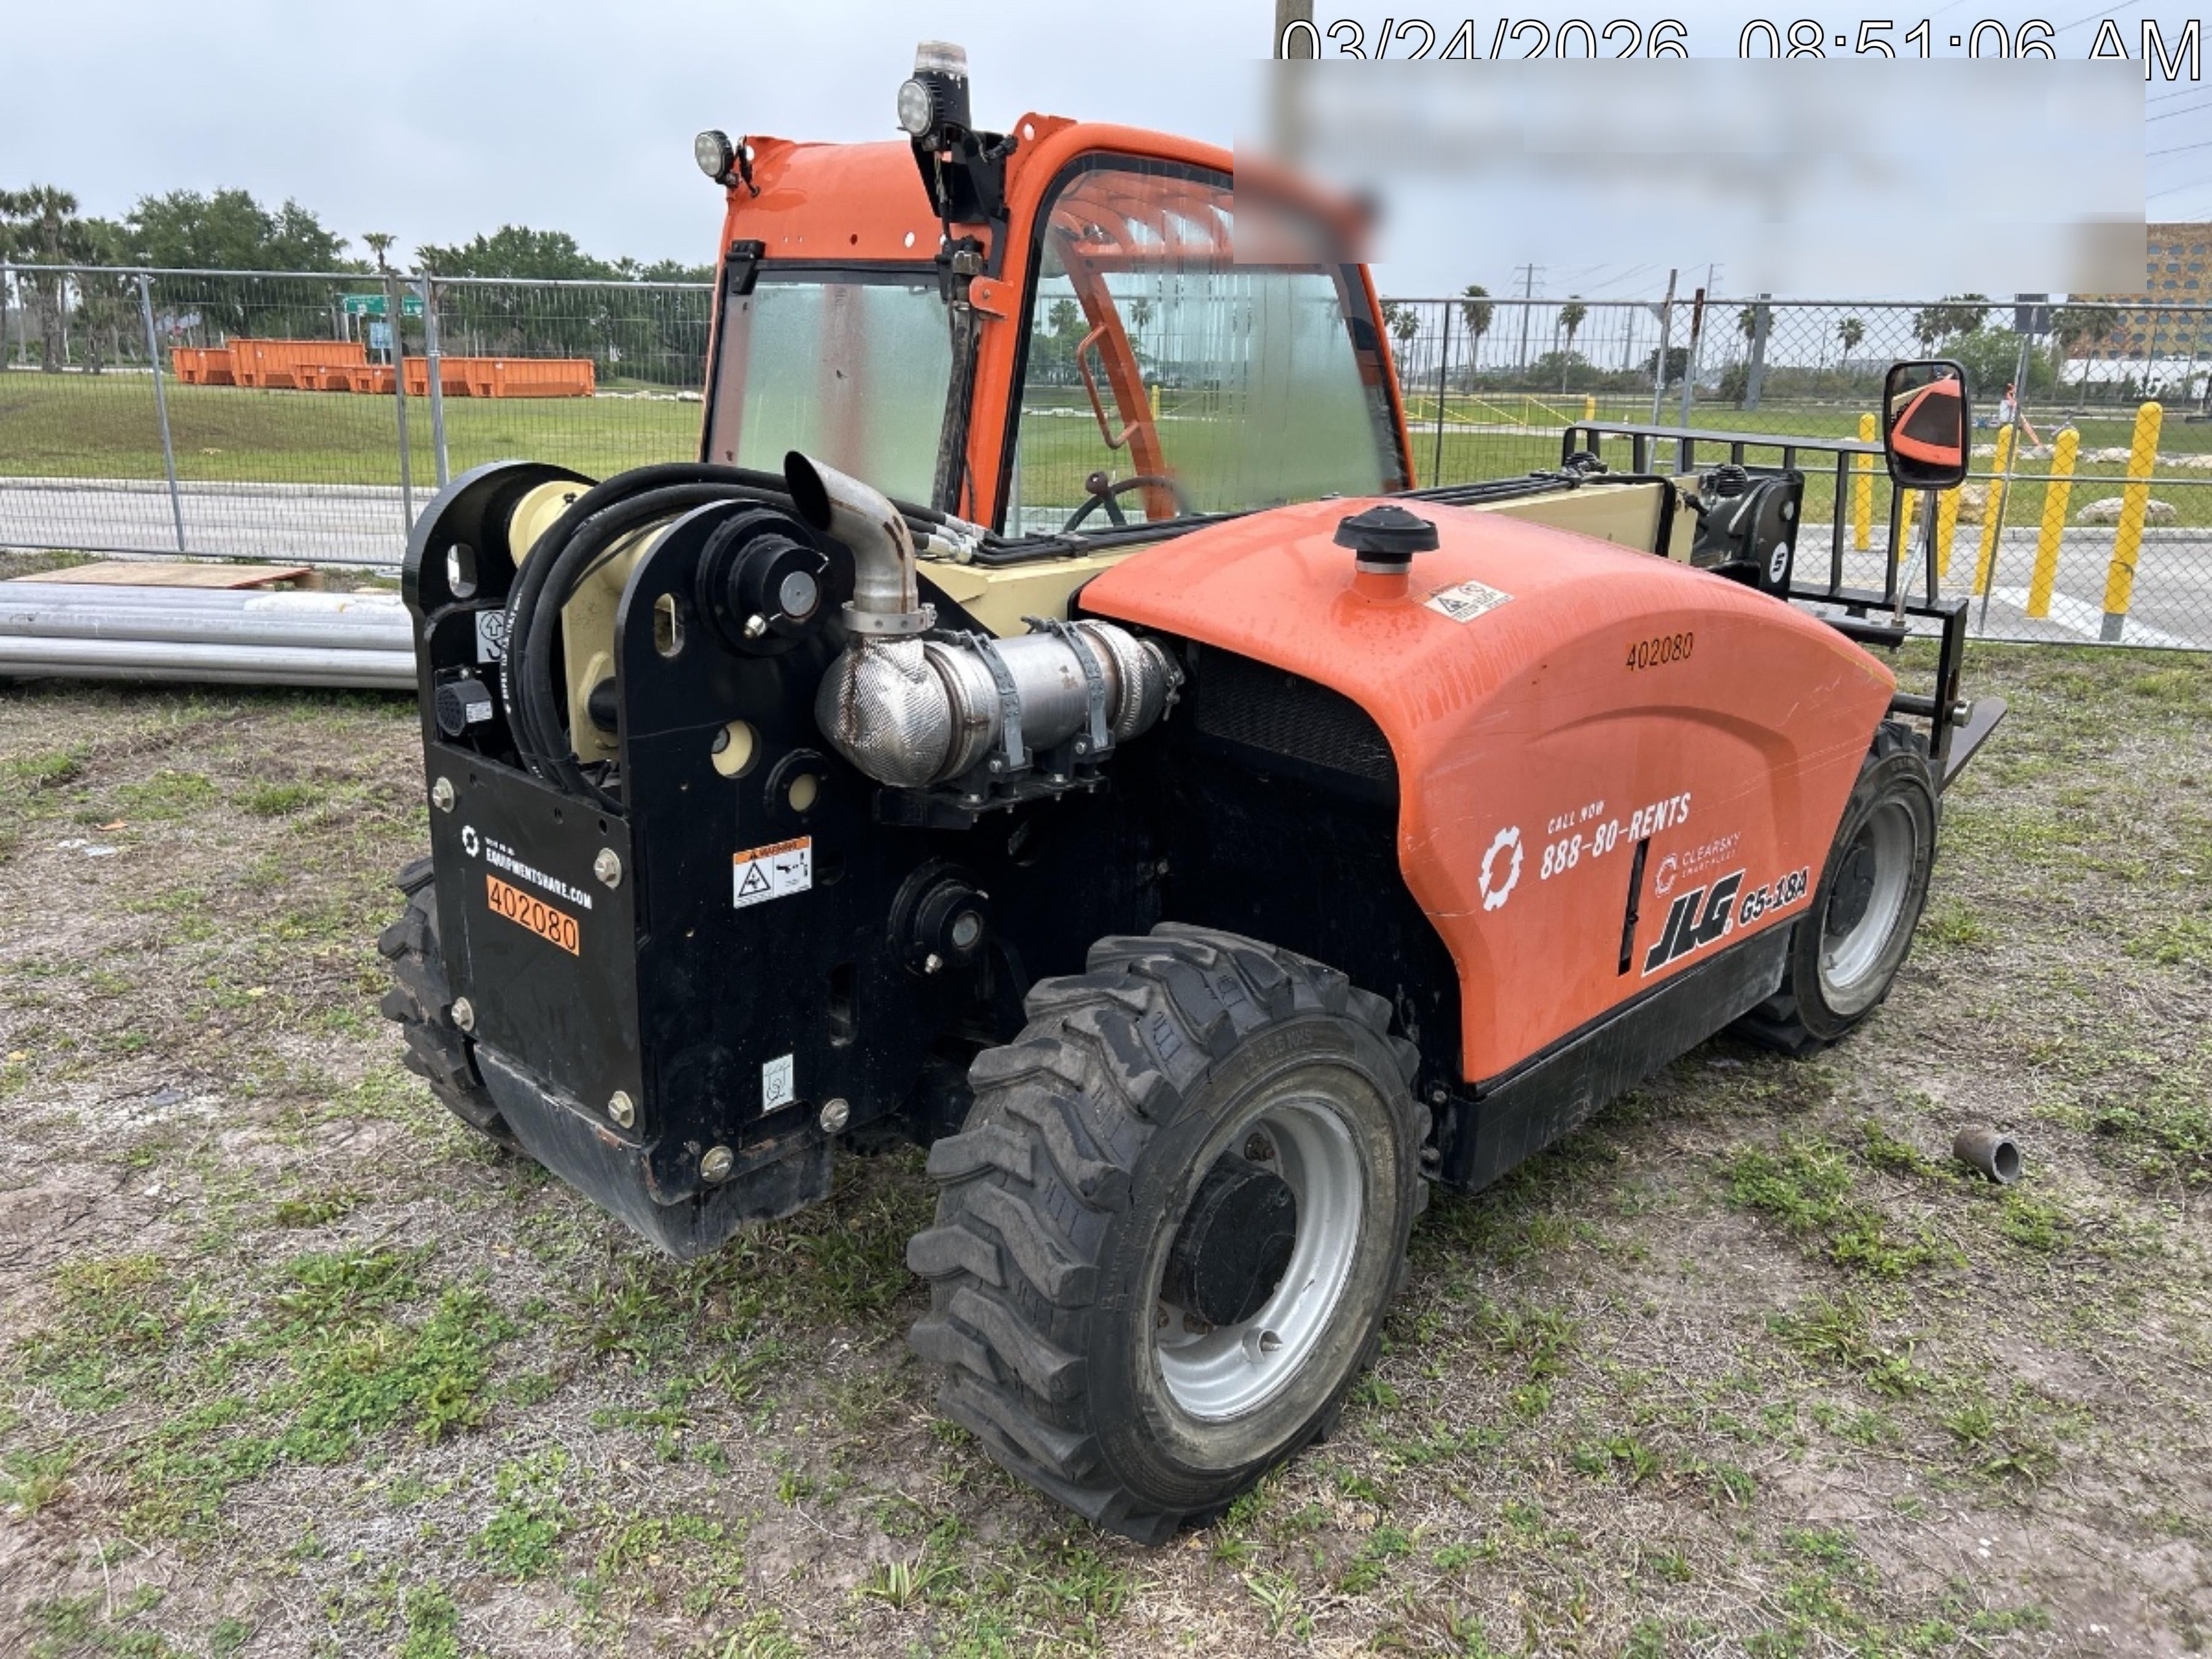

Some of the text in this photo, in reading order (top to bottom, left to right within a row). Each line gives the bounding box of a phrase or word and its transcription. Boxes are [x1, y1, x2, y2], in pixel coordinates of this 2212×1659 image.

[1625, 631, 1693, 672] 402080
[1540, 791, 1692, 880] 888-80-RENTS
[1548, 799, 1605, 834] CALL NOW
[485, 847, 593, 910] EQUIPMENTSHARE.COM
[1682, 831, 1741, 866] CLEARSKY
[491, 882, 577, 951] 402080
[1641, 865, 1811, 978] JLG G5-18A
